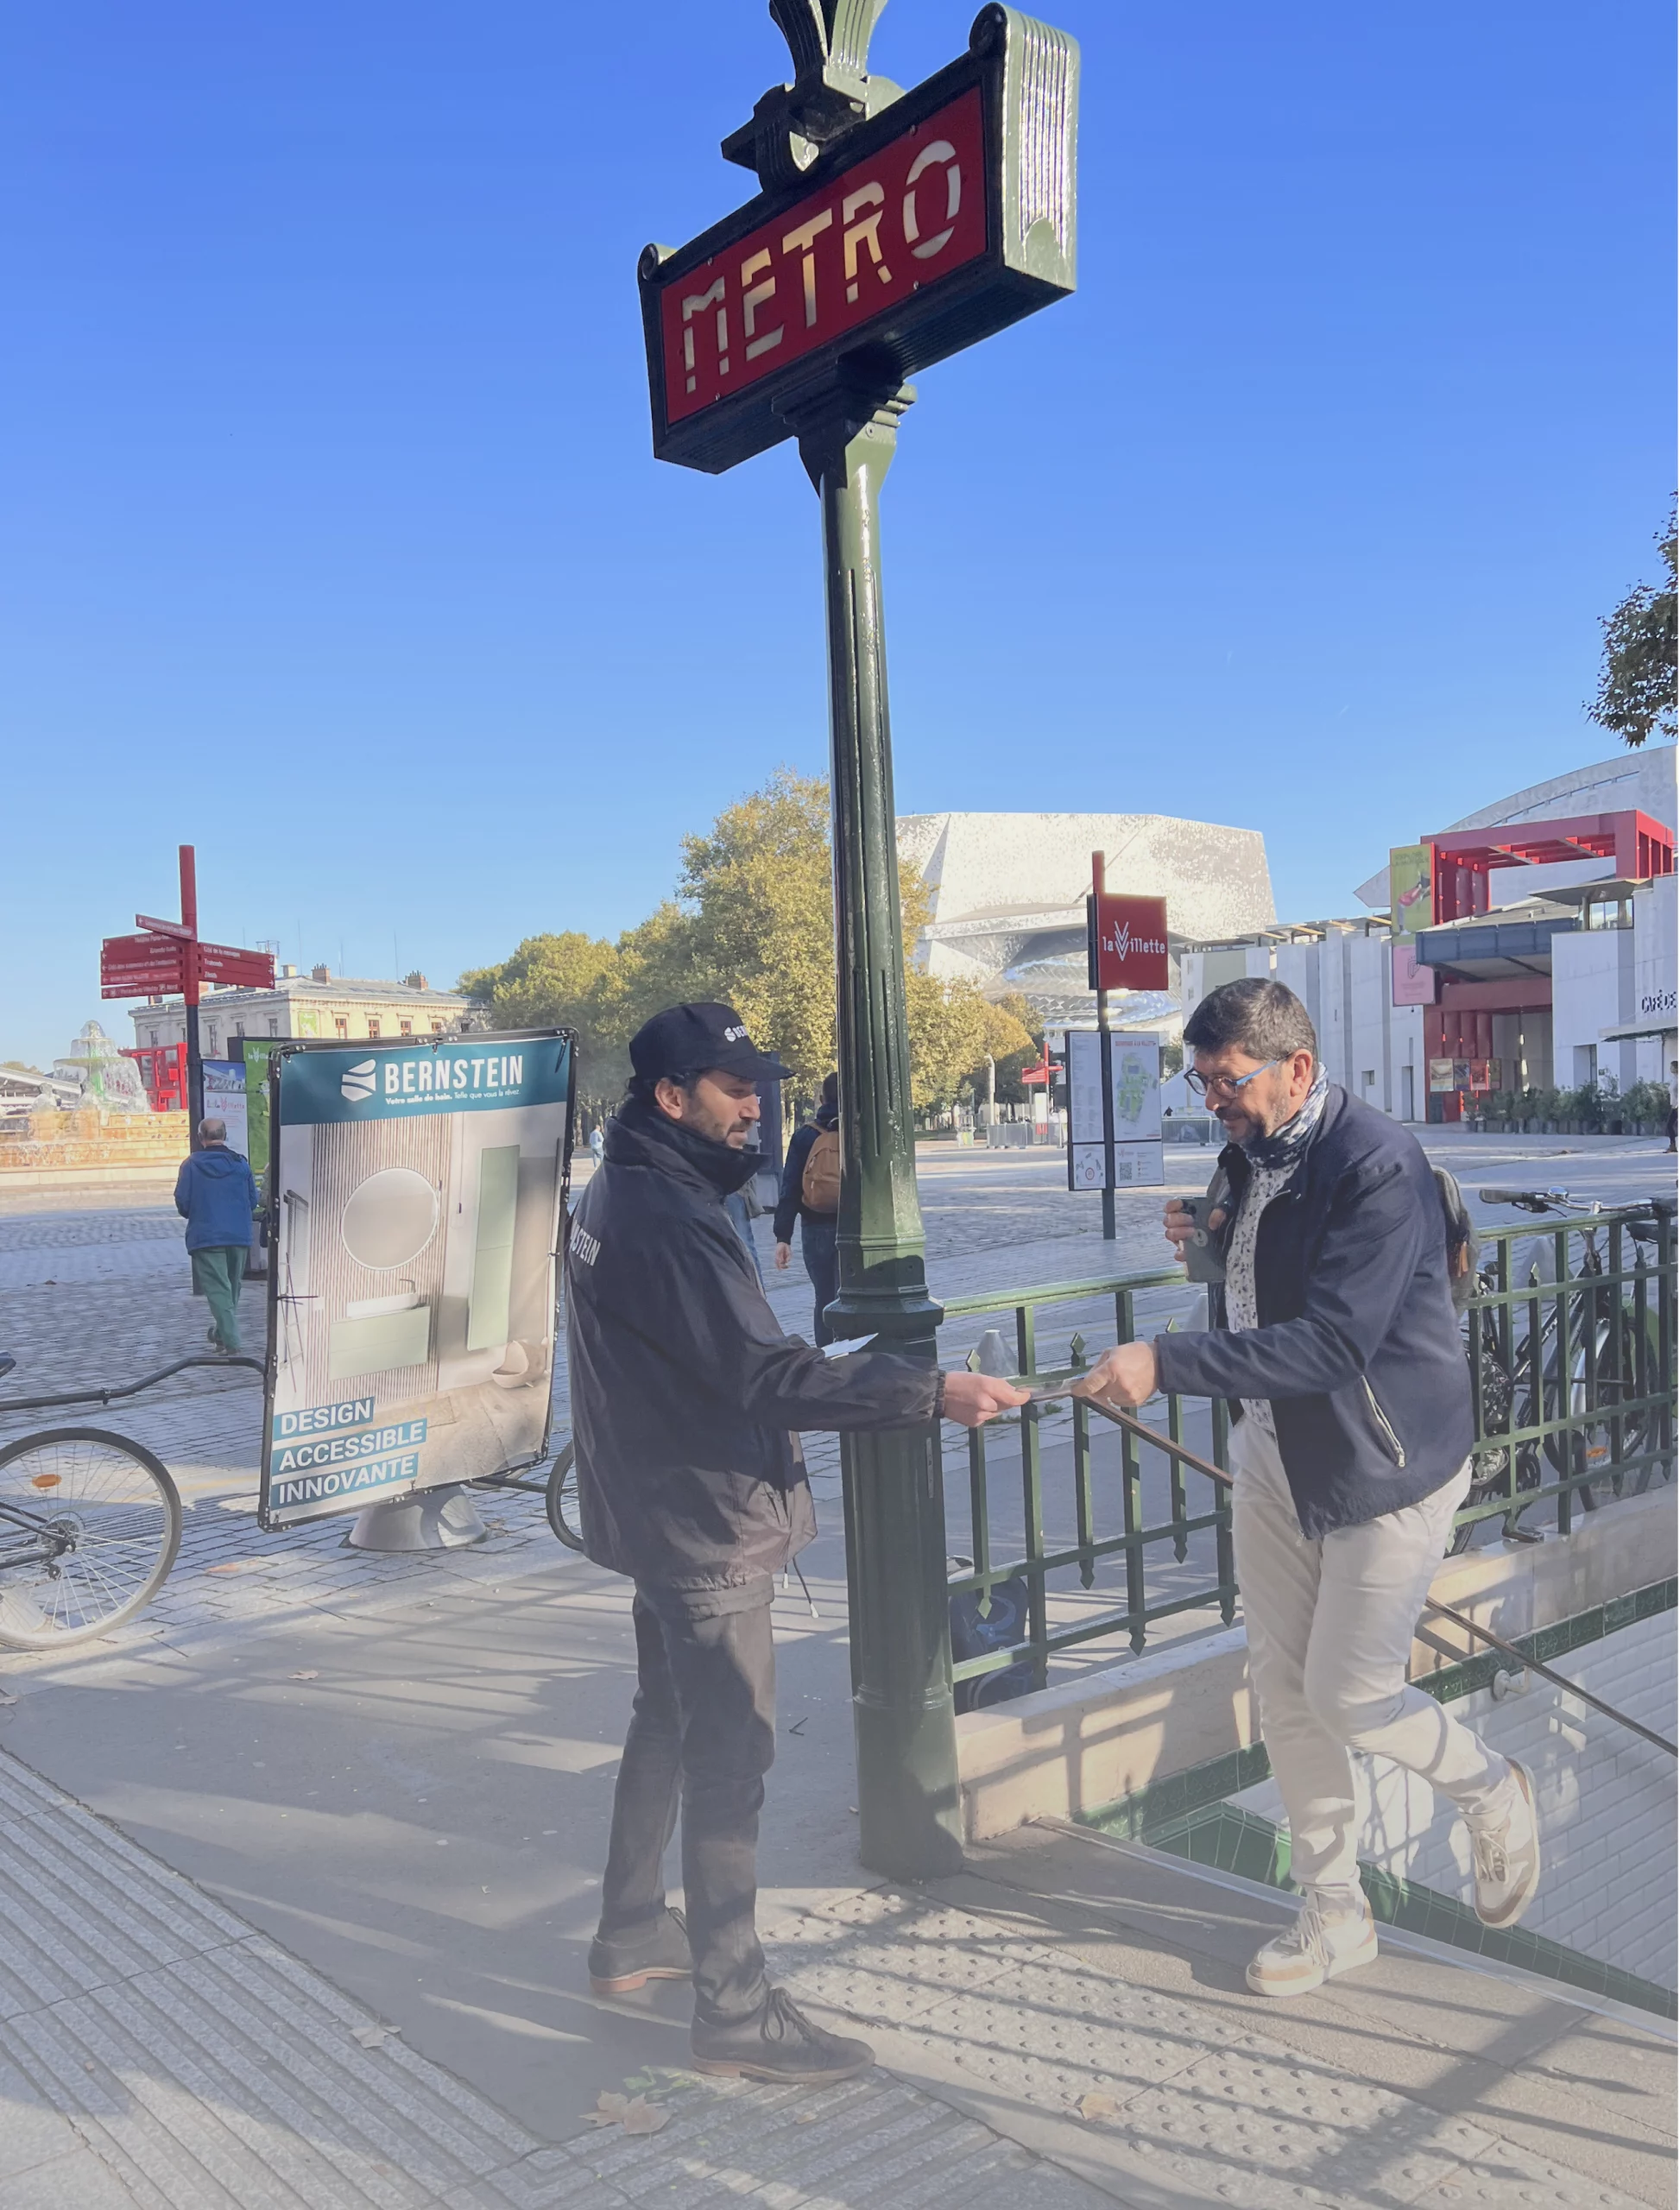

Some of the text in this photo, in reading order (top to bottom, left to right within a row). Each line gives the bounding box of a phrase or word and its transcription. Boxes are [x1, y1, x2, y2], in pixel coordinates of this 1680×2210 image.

[682, 140, 961, 394] METRO
[385, 1055, 523, 1094] BERNSTEIN
[407, 1095, 423, 1103] salle
[424, 1093, 434, 1102] de
[281, 1399, 371, 1435] DESIGN
[279, 1422, 424, 1471] ACCESSIBLE
[279, 1455, 415, 1504] INNOVANTE
